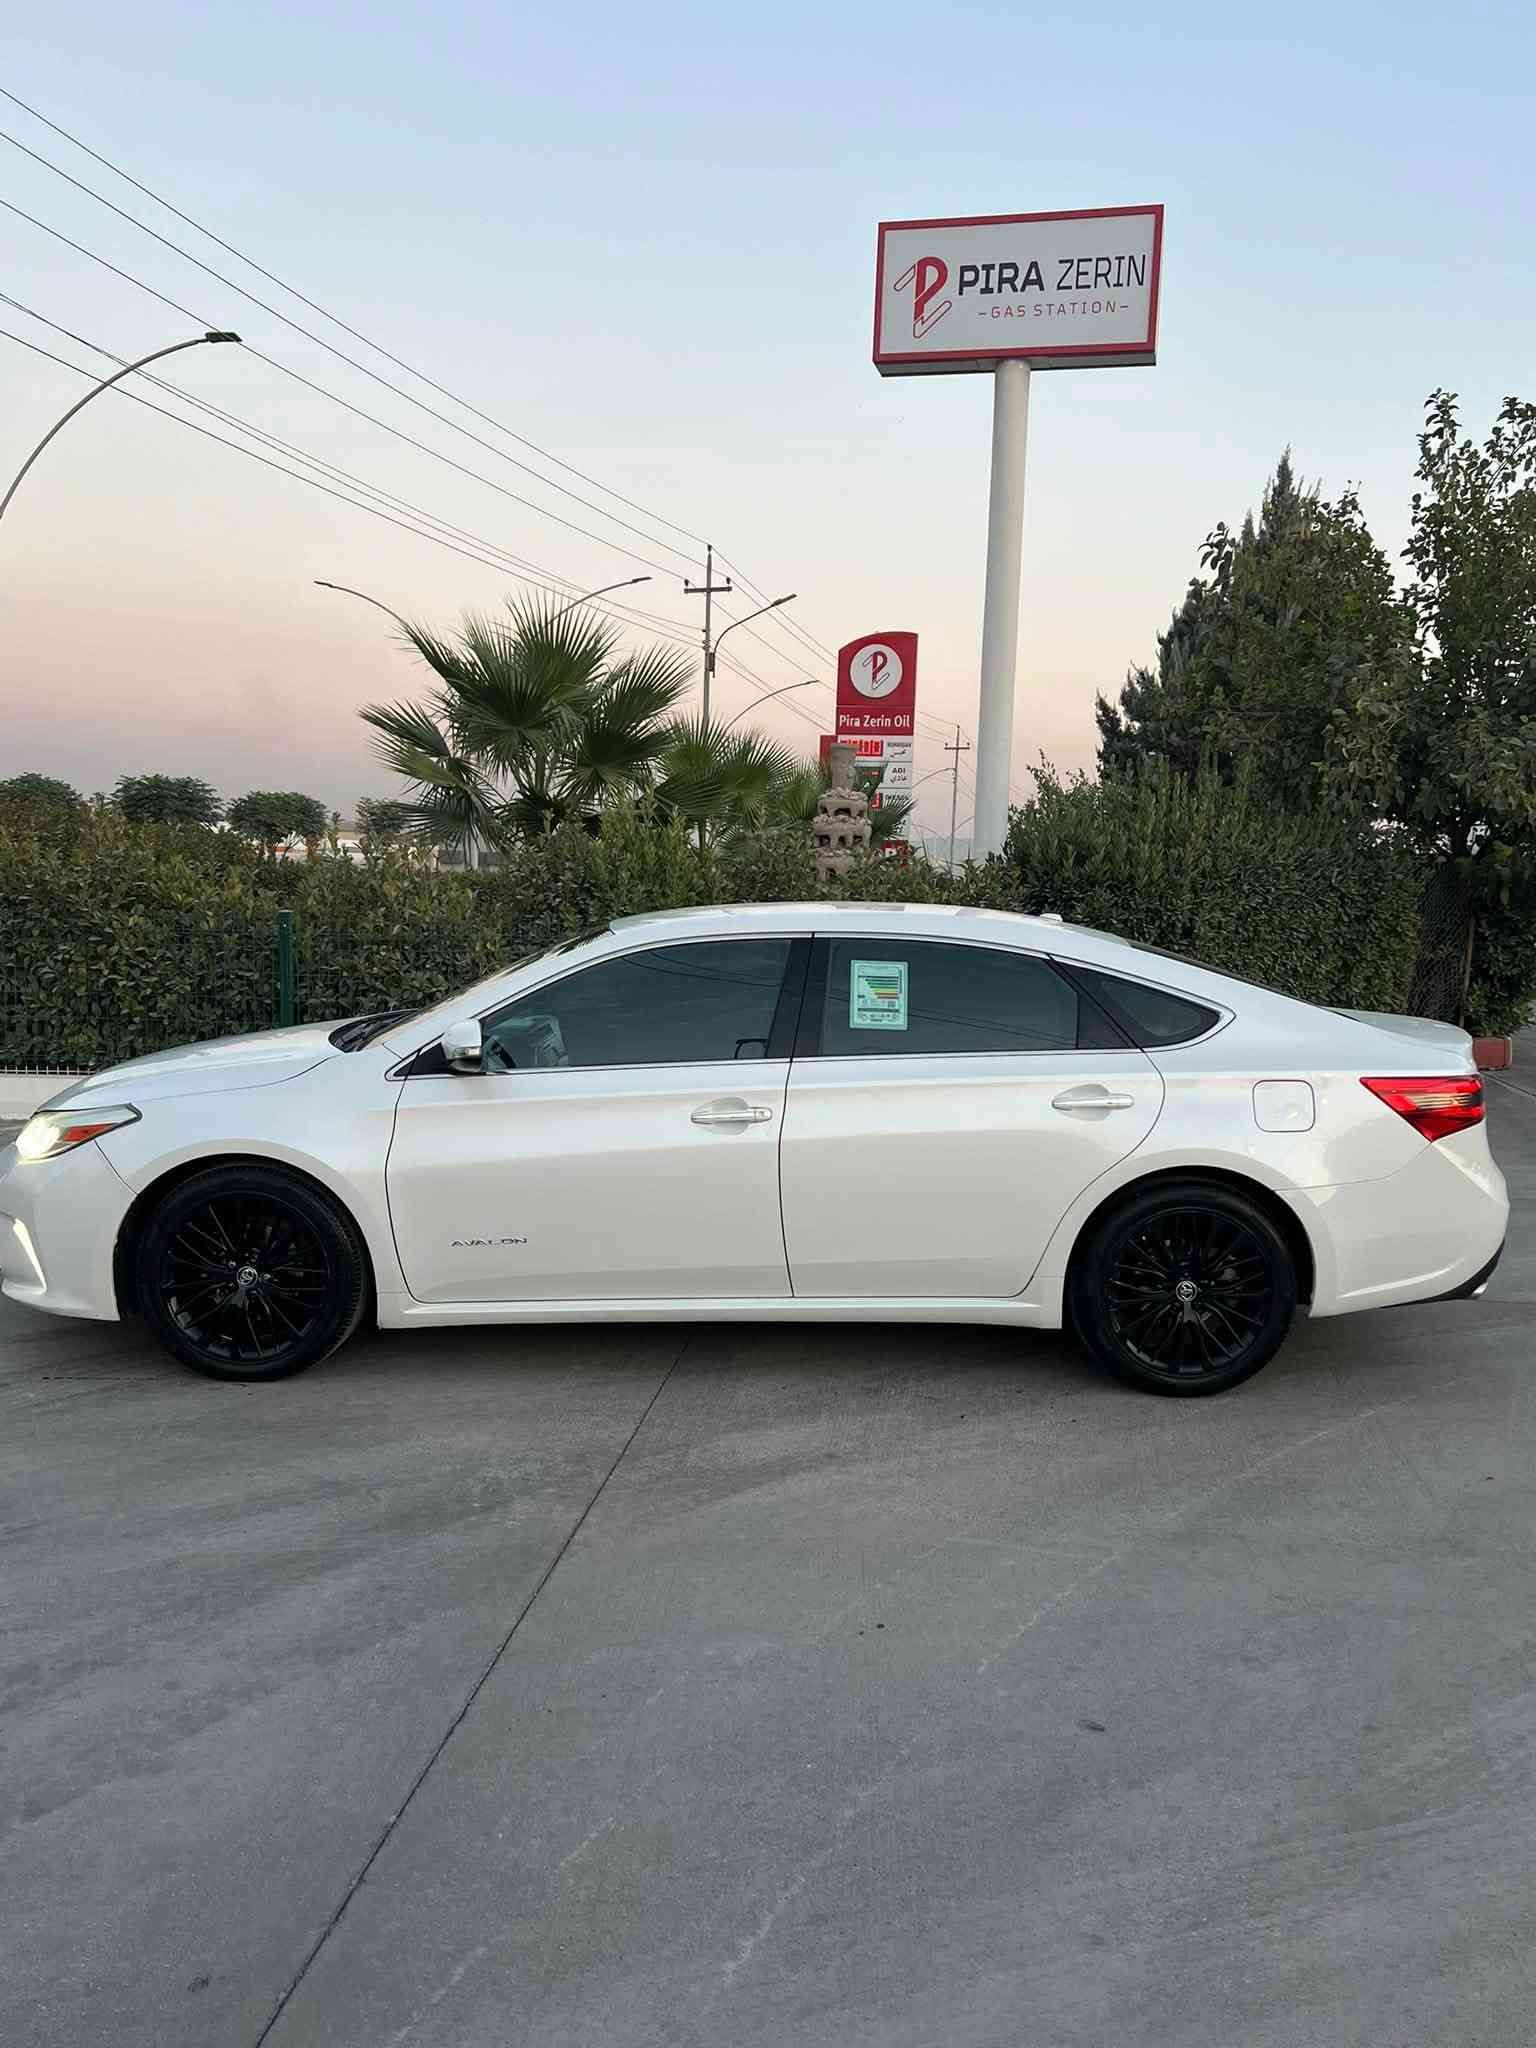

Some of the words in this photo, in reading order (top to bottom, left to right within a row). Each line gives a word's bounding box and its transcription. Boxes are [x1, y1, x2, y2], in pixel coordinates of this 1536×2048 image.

[958, 261, 1045, 296] PIRA
[1056, 254, 1146, 290] ZERIN
[839, 714, 860, 727] Pira
[863, 714, 891, 727] Zerin
[894, 714, 910, 727] Oil
[451, 1237, 528, 1248] AVALON
